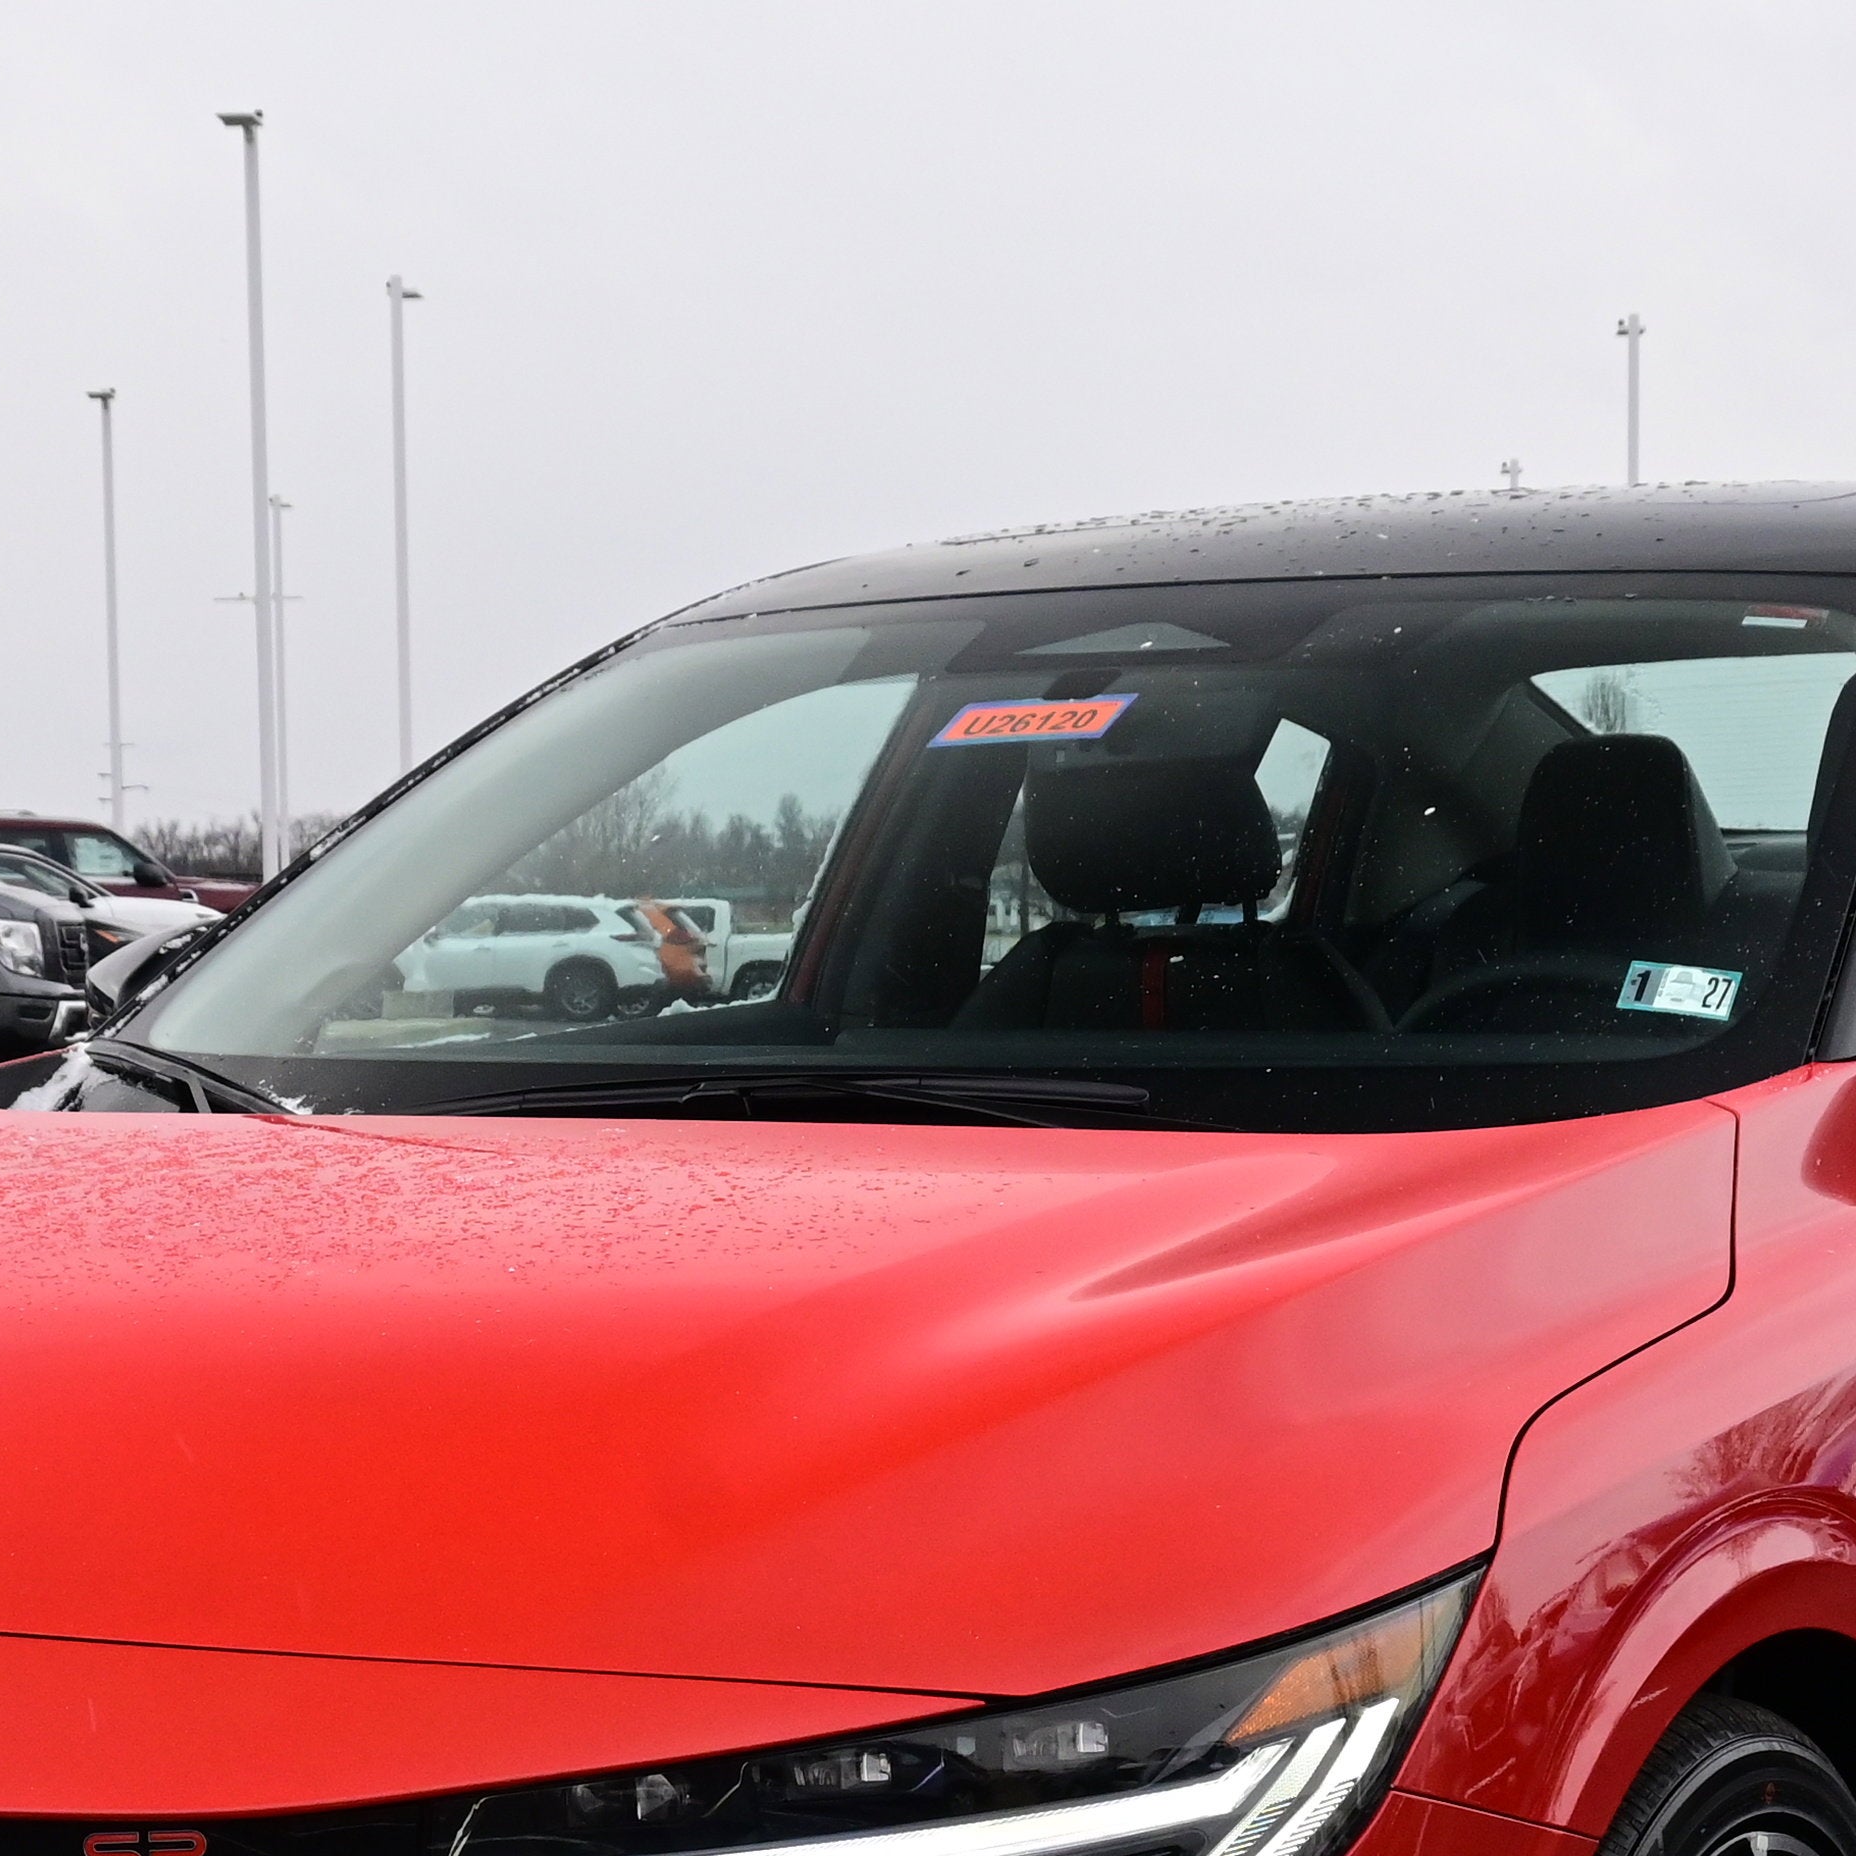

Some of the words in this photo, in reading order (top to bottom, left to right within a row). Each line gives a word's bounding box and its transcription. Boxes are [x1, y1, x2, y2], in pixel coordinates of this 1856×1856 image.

[963, 709, 1098, 736] U26120
[1634, 970, 1652, 1002] 1
[1702, 977, 1733, 1011] 27
